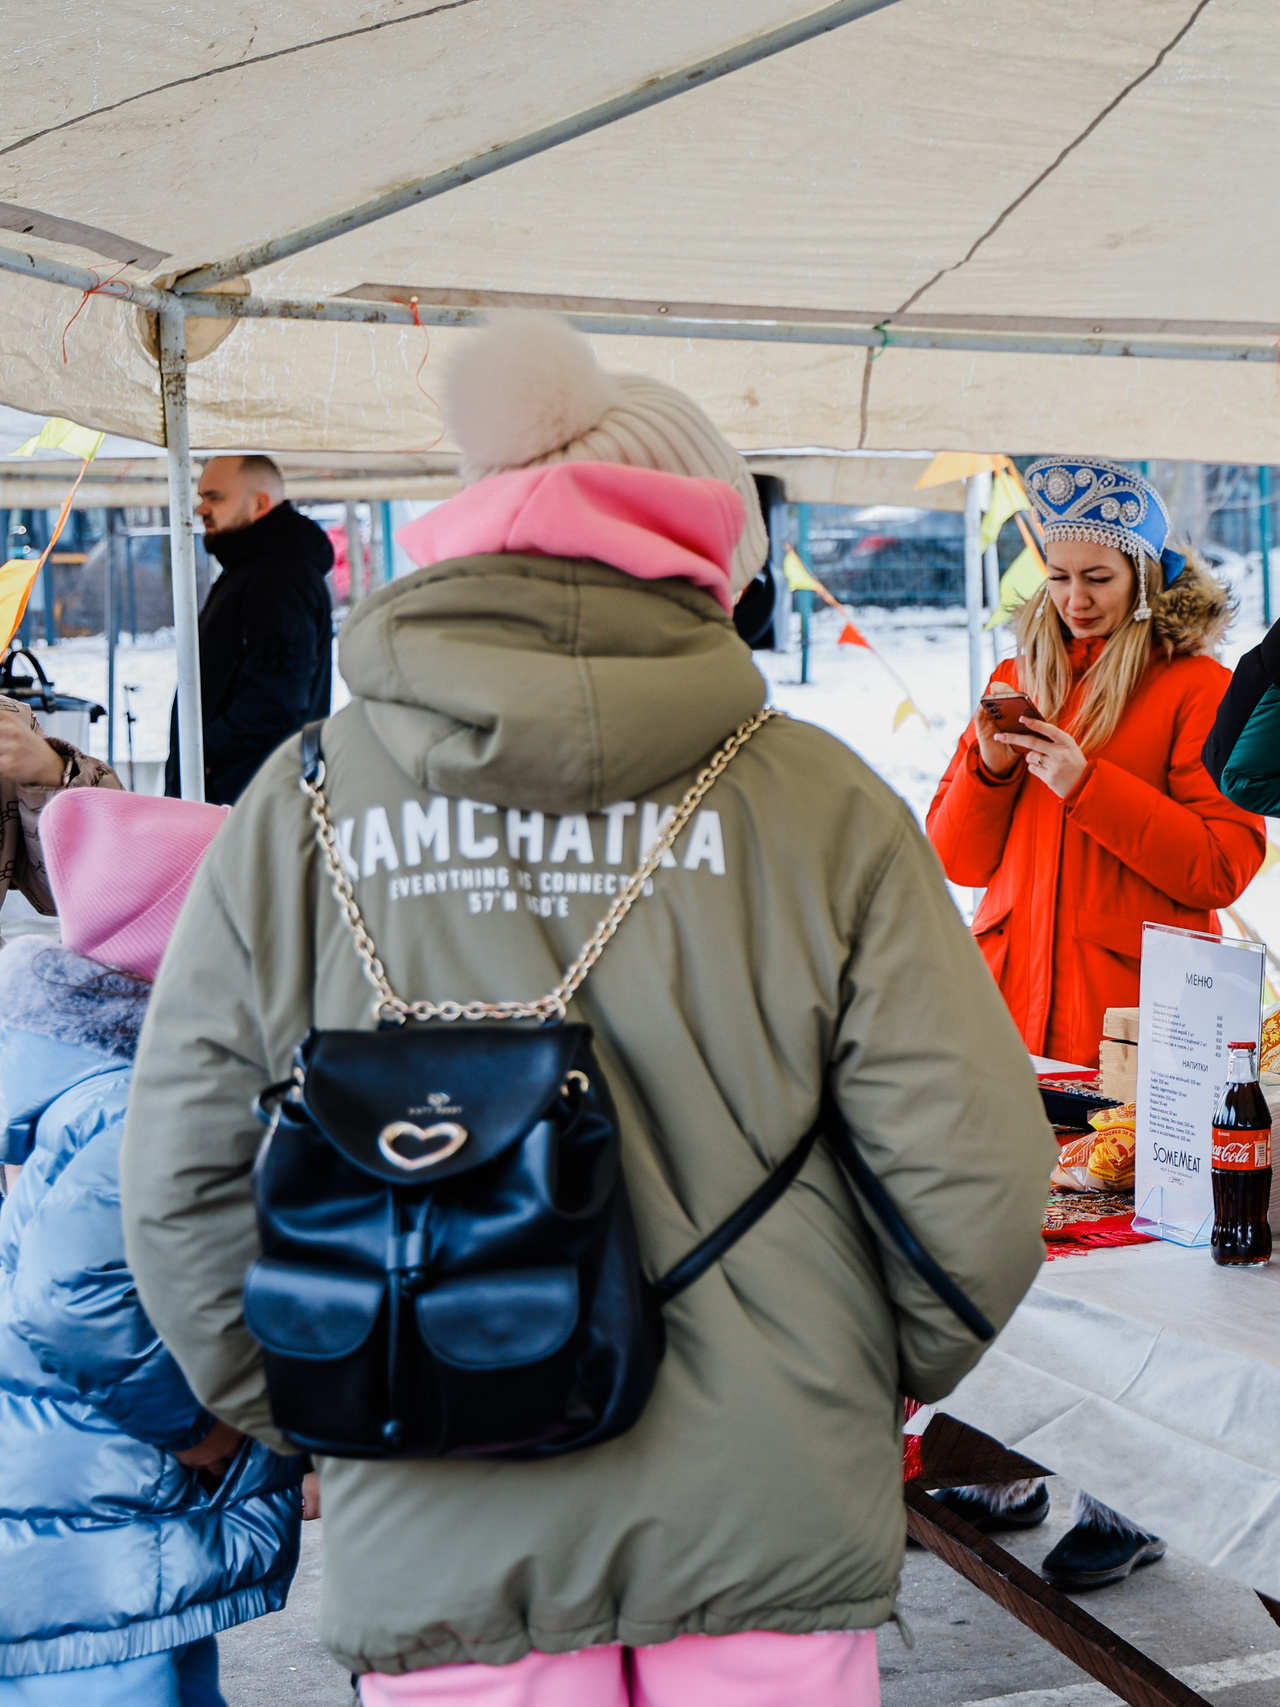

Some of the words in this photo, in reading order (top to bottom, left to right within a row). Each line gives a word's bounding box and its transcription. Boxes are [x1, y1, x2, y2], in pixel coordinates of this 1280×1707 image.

[389, 866, 509, 901] EVERYTHING
[518, 869, 532, 891] IS
[1185, 972, 1213, 989] МЕНЮ
[1182, 1059, 1209, 1072] НАПИТКИ
